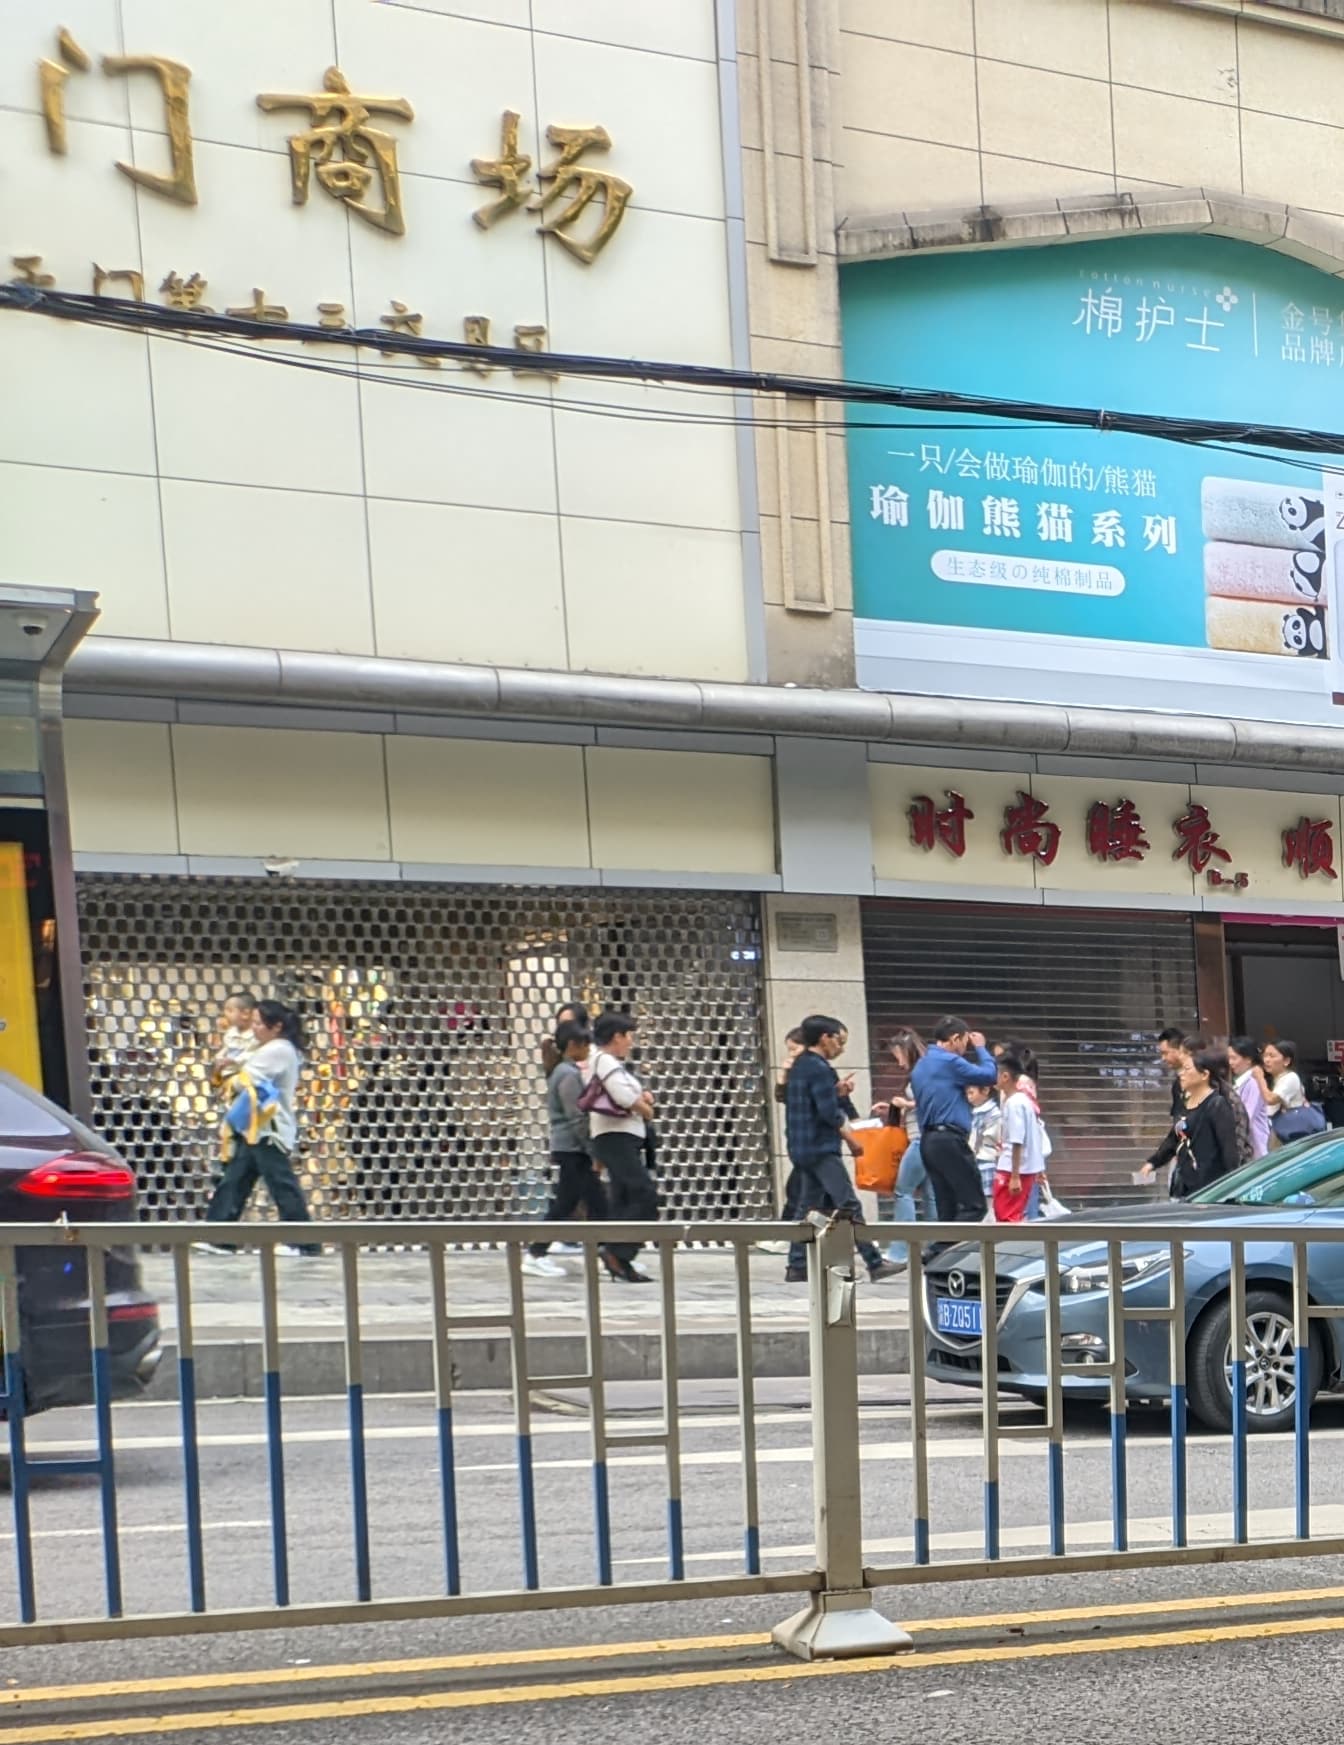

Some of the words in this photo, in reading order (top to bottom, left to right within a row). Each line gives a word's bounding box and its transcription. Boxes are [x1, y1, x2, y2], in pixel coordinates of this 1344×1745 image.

[38, 25, 635, 264] 门商场
[1072, 286, 1225, 352] 棉护士
[887, 445, 1158, 499] 一只/会做瑜伽的/熊猫
[868, 482, 1179, 556] 瑜伽熊猫系列
[945, 556, 1115, 592] 生态级の纯棉制品
[907, 790, 1232, 873] 时尚睡衣
